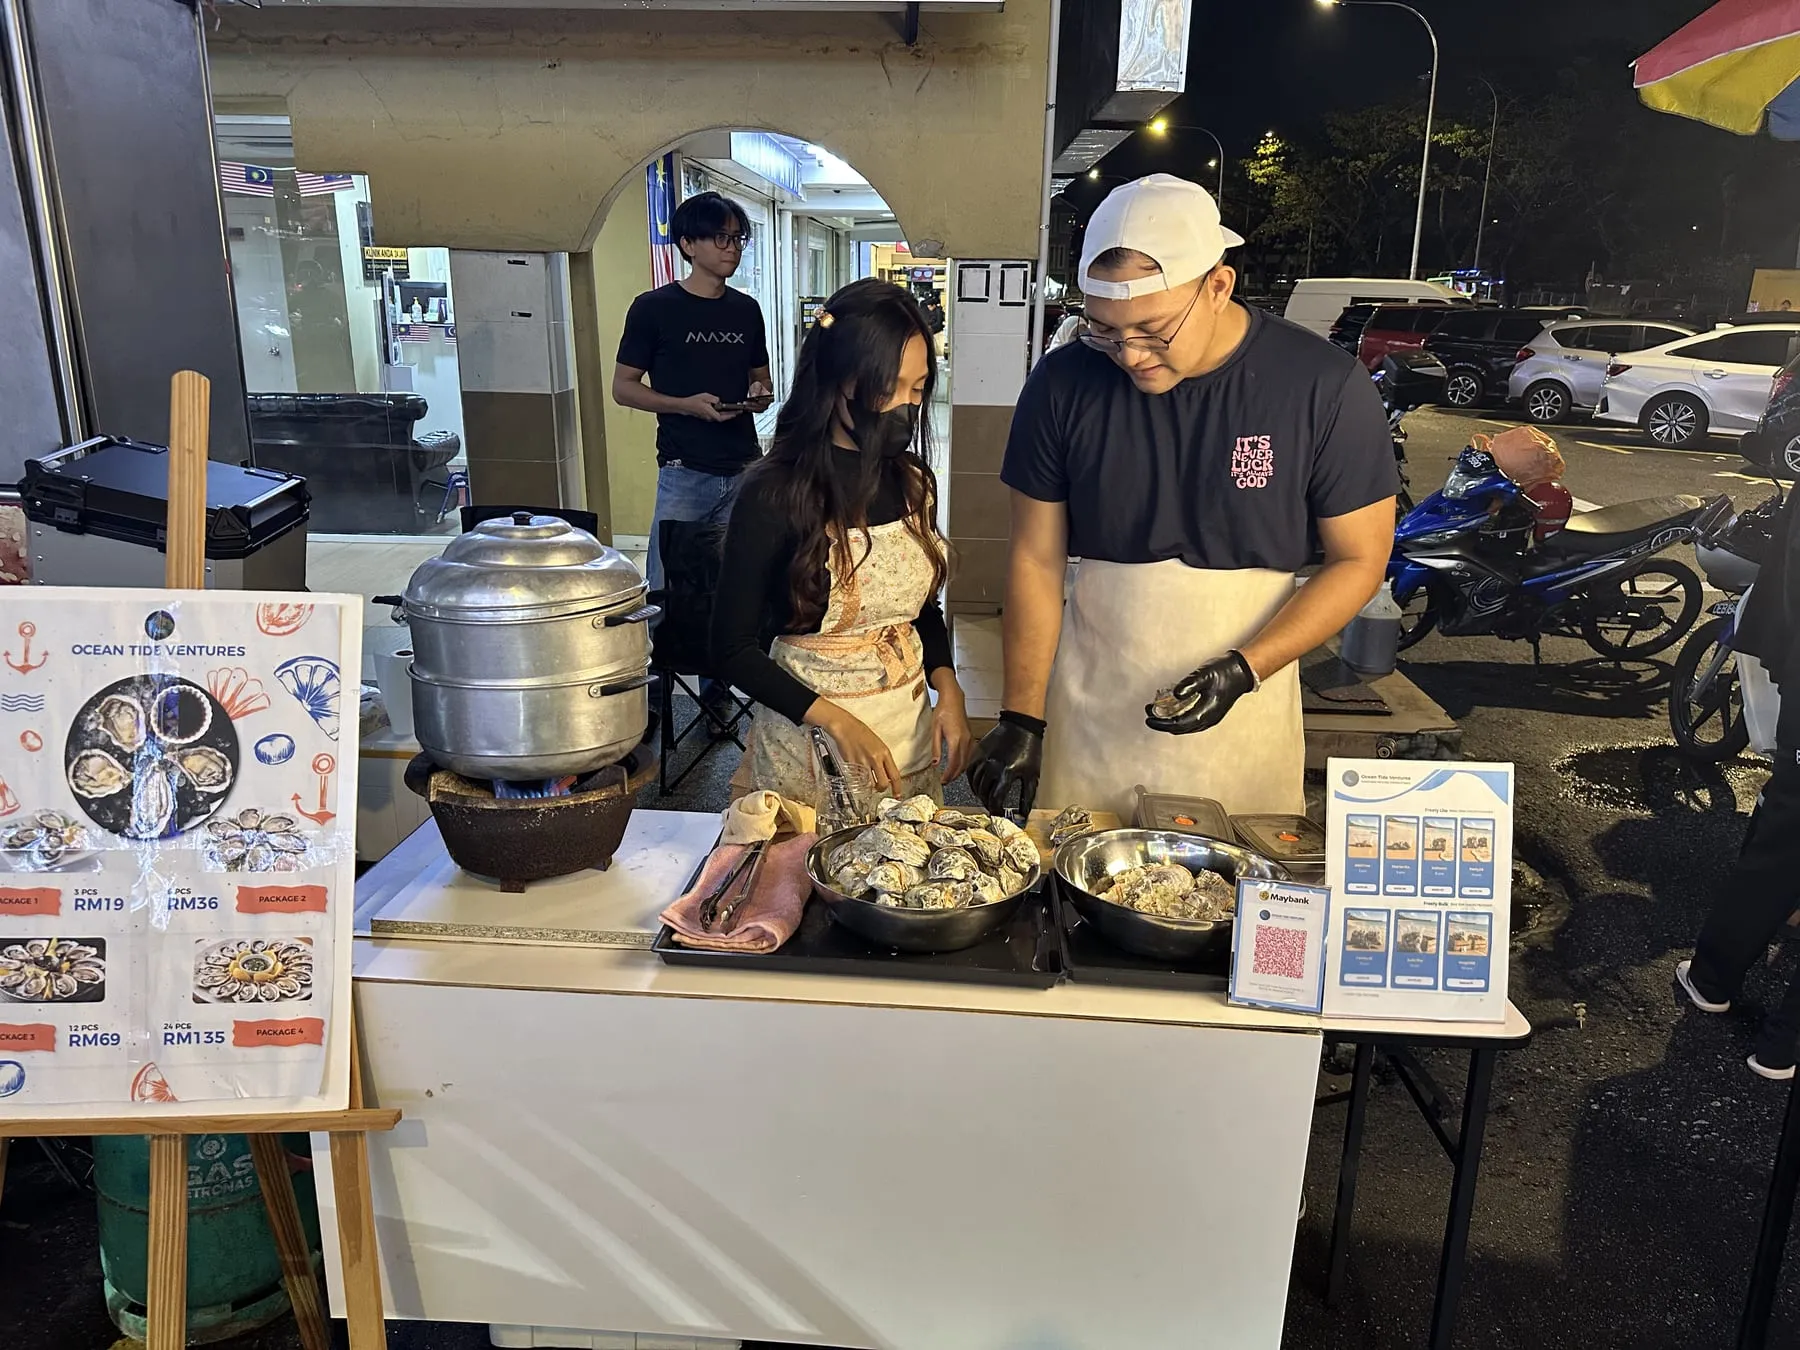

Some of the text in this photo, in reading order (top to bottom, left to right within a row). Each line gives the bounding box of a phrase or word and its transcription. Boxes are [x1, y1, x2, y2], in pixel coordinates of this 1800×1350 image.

[1235, 435, 1271, 452] IT'S
[1231, 449, 1274, 462] NEVER
[1231, 459, 1274, 473] LUCK
[1246, 470, 1274, 478] ALWAYS
[1236, 475, 1267, 489] GOD
[71, 644, 246, 657] OCEAN TIDE VENTURES
[74, 888, 98, 896] 3 PCS
[0, 897, 39, 905] ACKAGE 1
[74, 897, 125, 911] RM19
[167, 896, 219, 911] RM36
[258, 895, 297, 903] PACKAGE
[1270, 893, 1310, 905] Maybank
[81, 1023, 99, 1032] PCS
[175, 1022, 192, 1030] PCS
[256, 1027, 304, 1036] PACKAGE 4
[0, 1033, 36, 1041] CKAGE 3
[69, 1032, 121, 1047] RM69
[163, 1030, 225, 1046] RM135
[188, 1175, 253, 1199] ETRONAS
